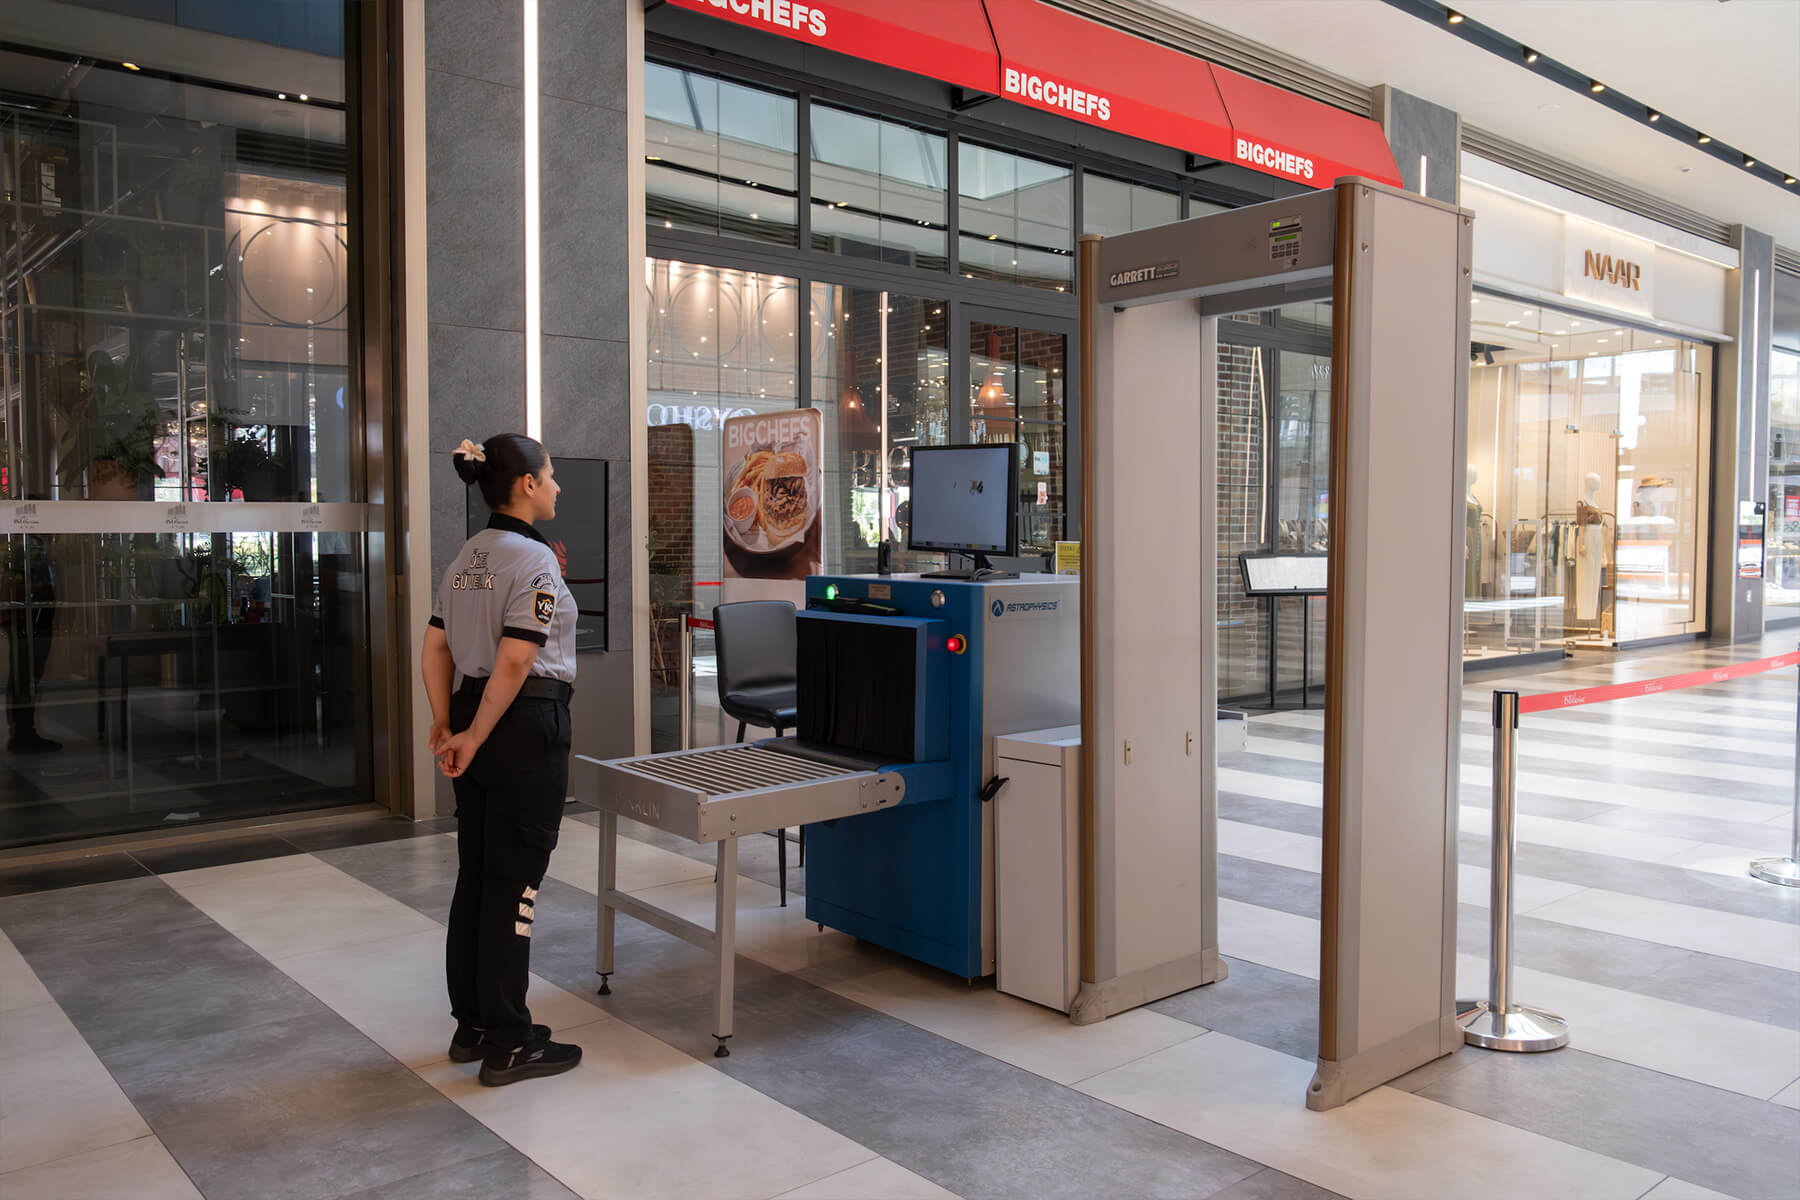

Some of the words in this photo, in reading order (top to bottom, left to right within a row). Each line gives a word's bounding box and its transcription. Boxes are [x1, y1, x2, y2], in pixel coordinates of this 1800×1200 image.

[1005, 68, 1111, 121] BIGCHEFS
[1236, 138, 1314, 179] BIGCHEFS
[1110, 266, 1157, 286] GARRETT
[1584, 249, 1640, 291] NAAR
[728, 416, 811, 448] BIGCHEFS
